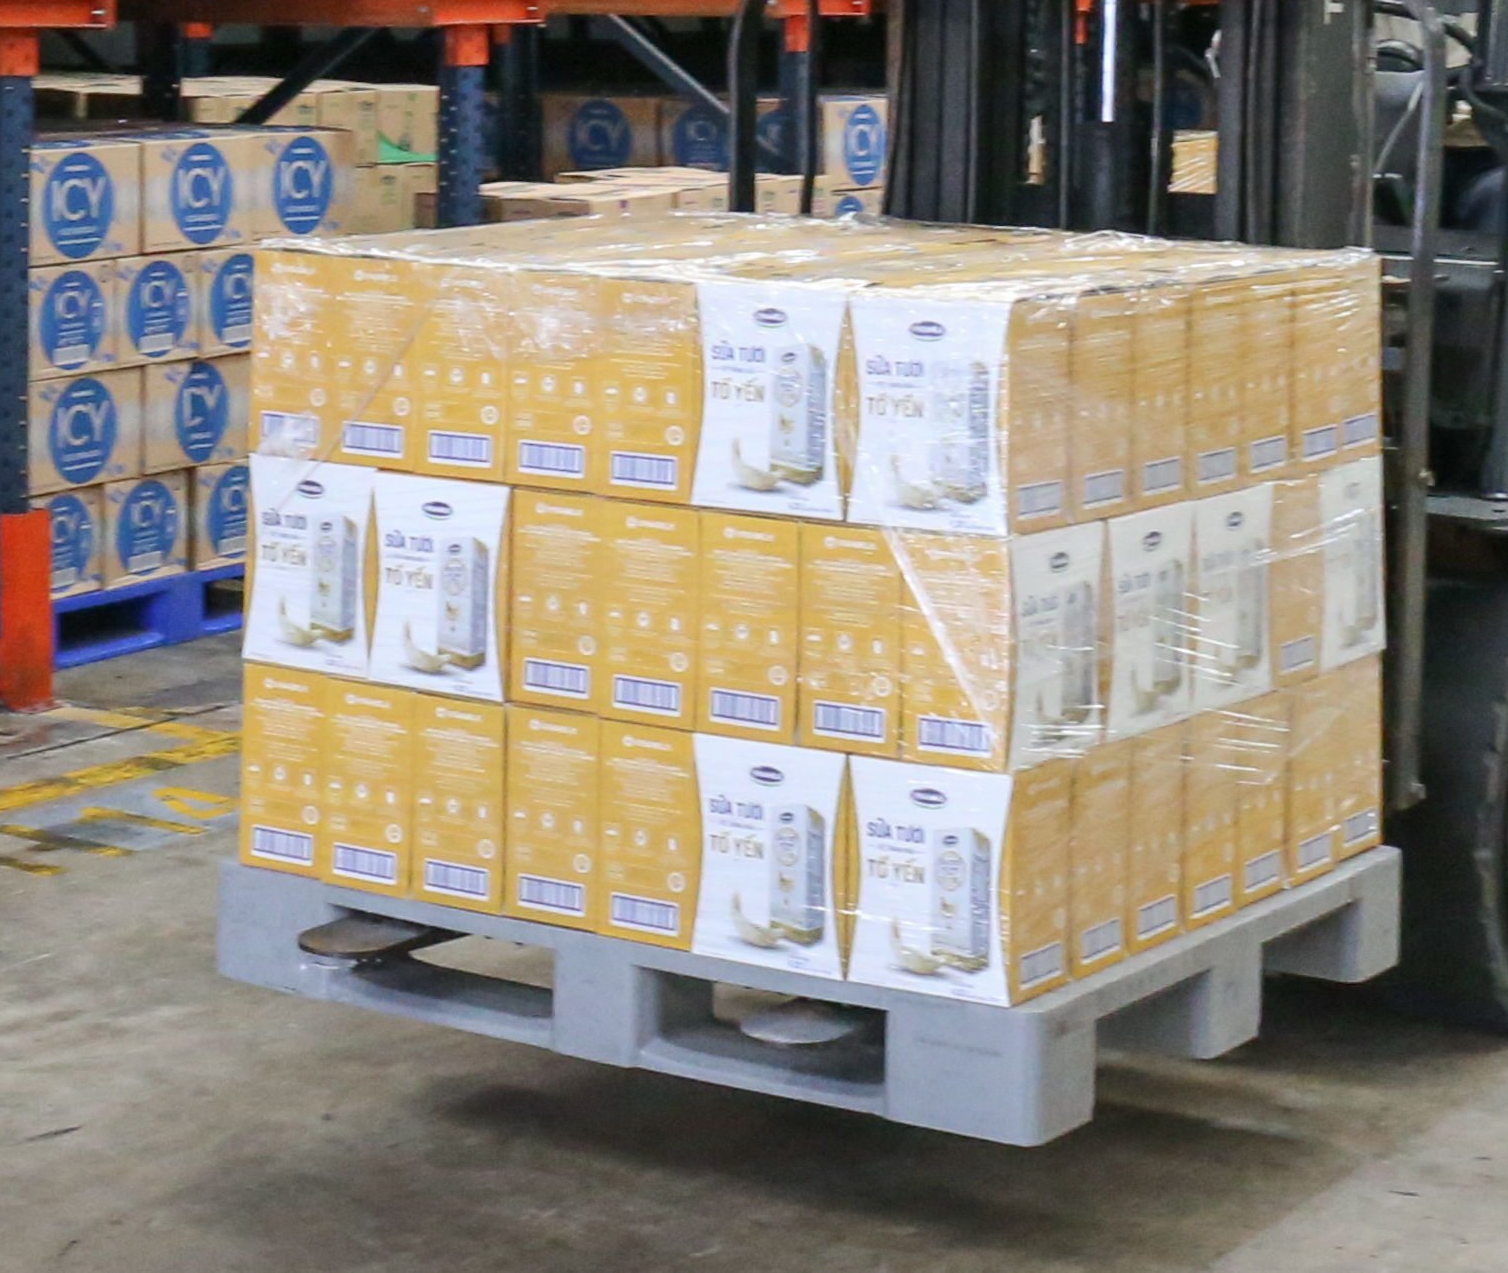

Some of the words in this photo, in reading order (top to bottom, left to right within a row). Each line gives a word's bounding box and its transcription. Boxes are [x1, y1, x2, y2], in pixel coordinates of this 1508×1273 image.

[178, 169, 223, 208] ICY
[280, 161, 322, 199] ICY
[51, 179, 103, 221] ICY
[55, 290, 91, 319] ICY
[139, 282, 176, 308] ICY
[57, 402, 110, 446] ICY
[129, 501, 167, 527] ICY
